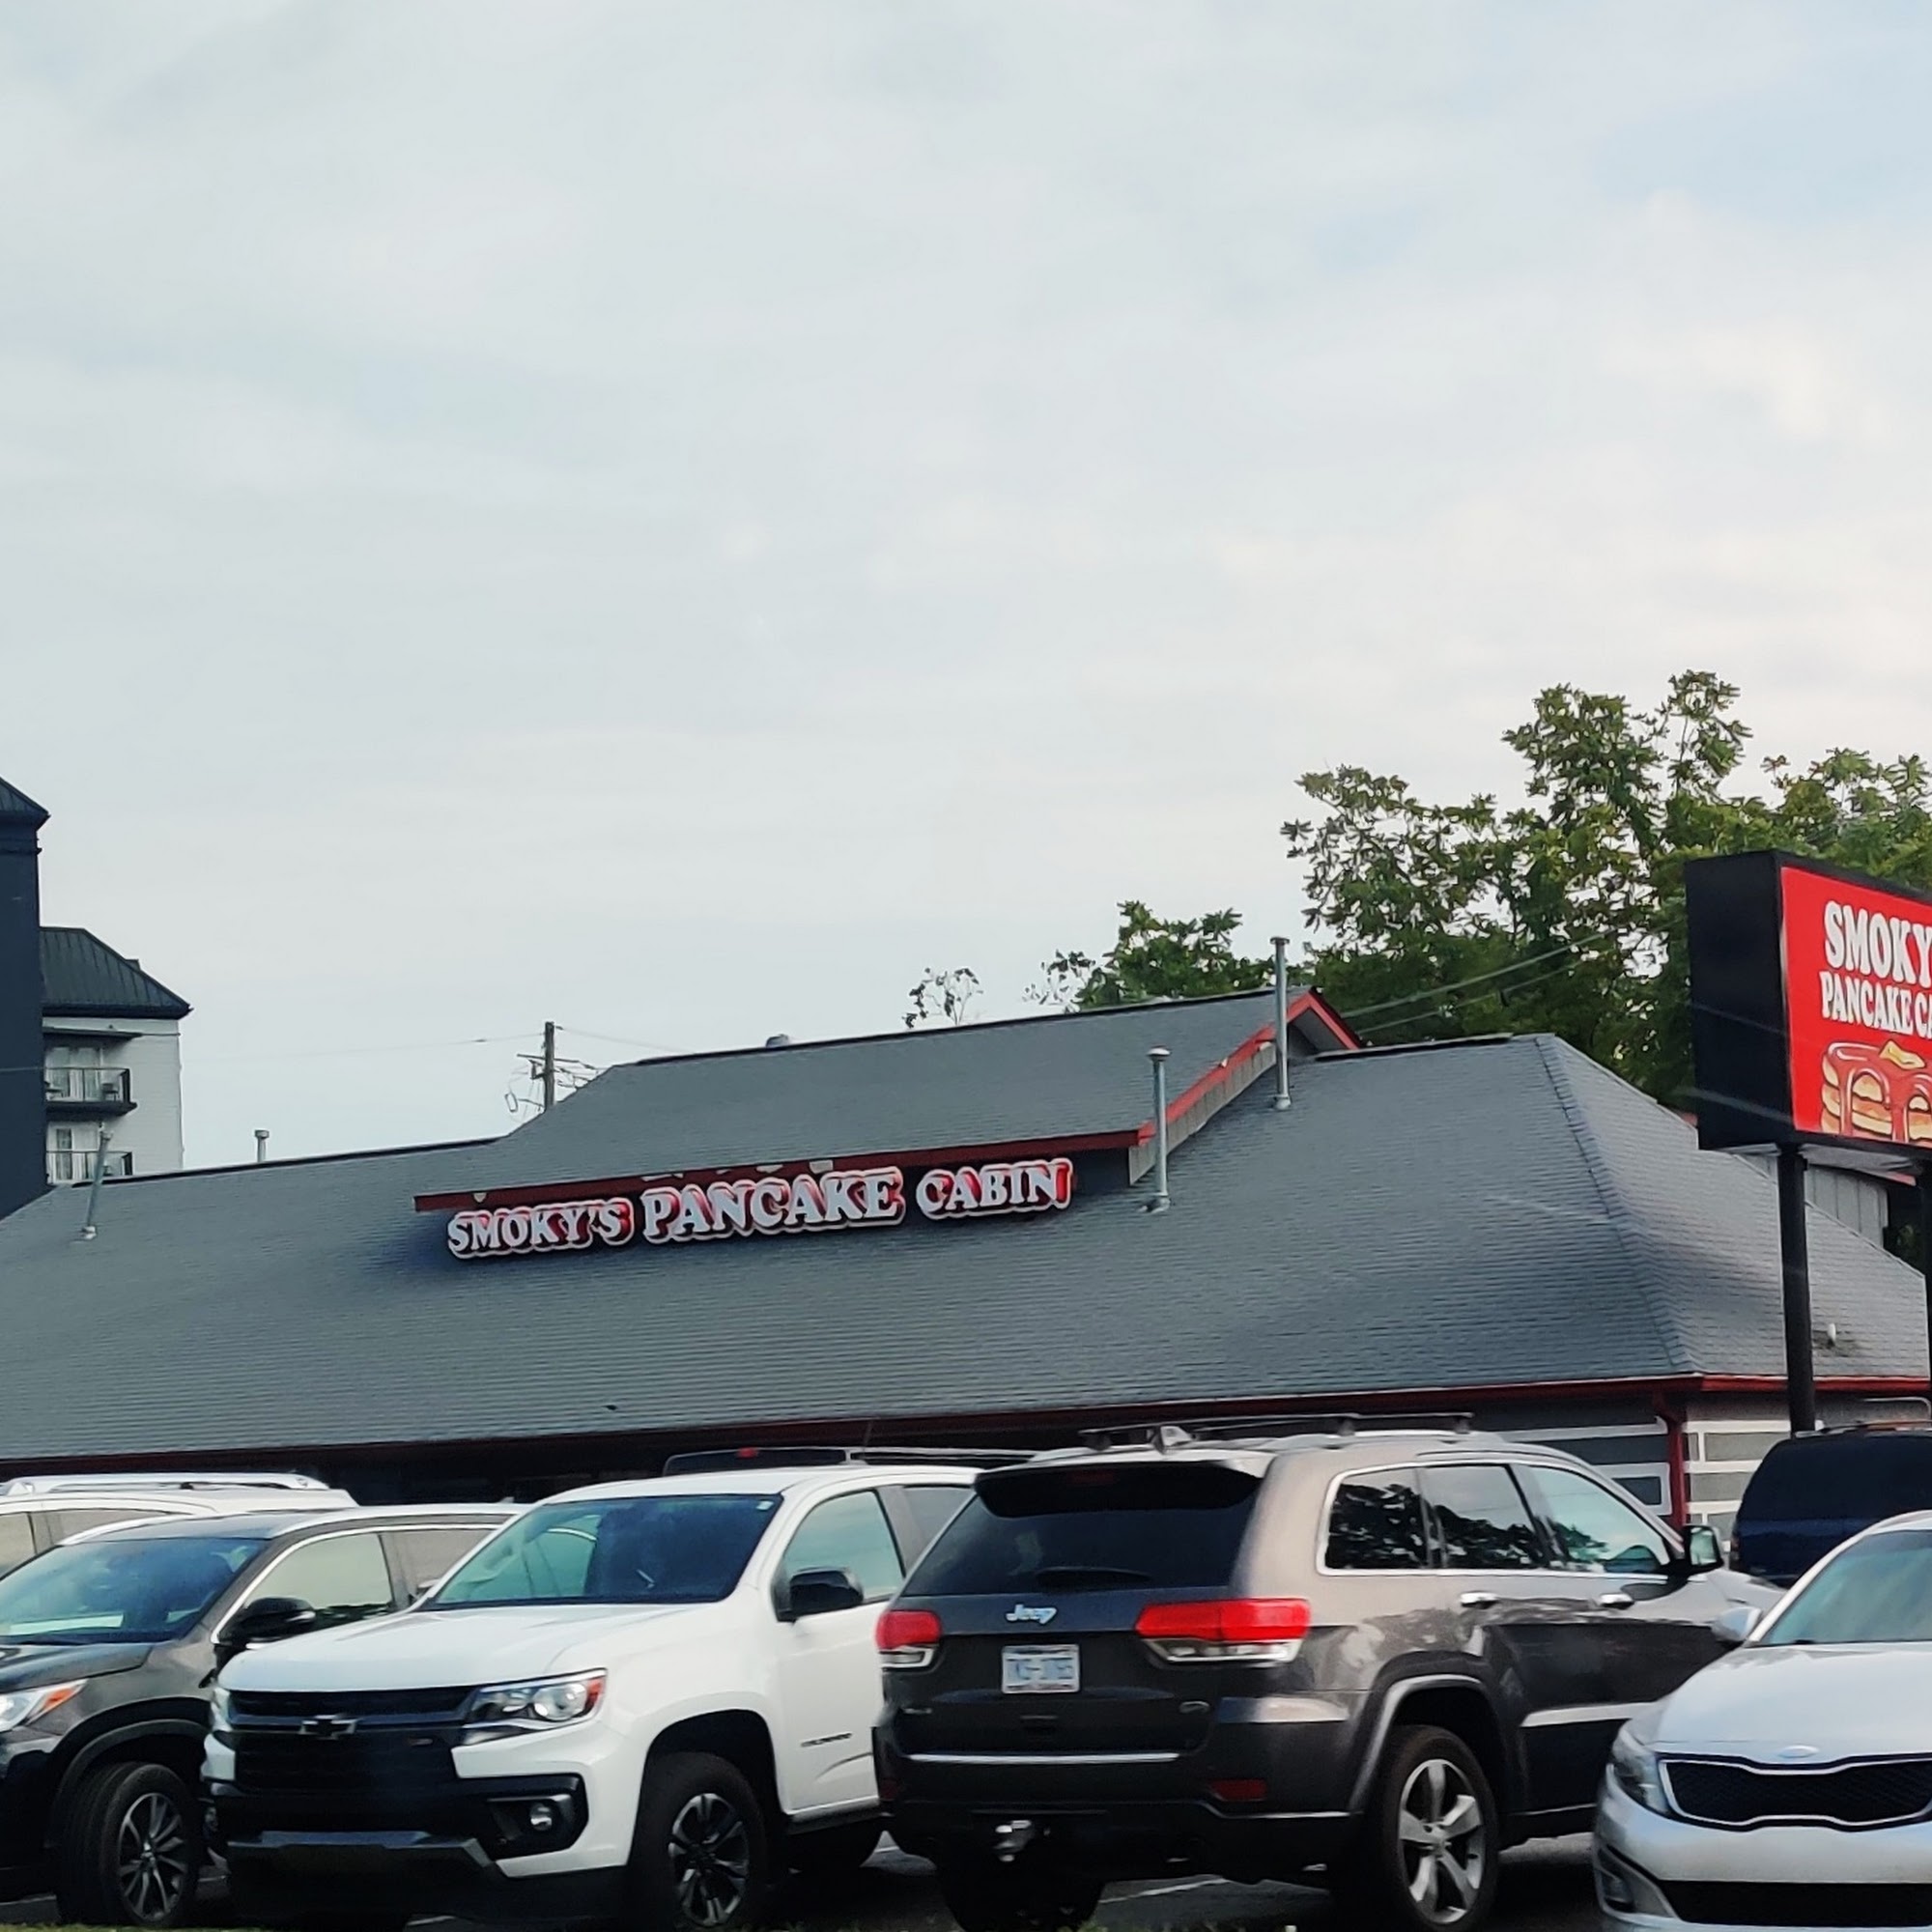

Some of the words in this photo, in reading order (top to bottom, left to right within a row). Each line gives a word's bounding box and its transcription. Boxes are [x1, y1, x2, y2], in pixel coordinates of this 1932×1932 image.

[1824, 900, 1932, 988] SMOKY
[1819, 971, 1914, 1036] PANCAKE
[447, 1198, 634, 1259] SMOKY'S
[640, 1166, 906, 1244] PANCAKE
[917, 1158, 1073, 1220] CABIN
